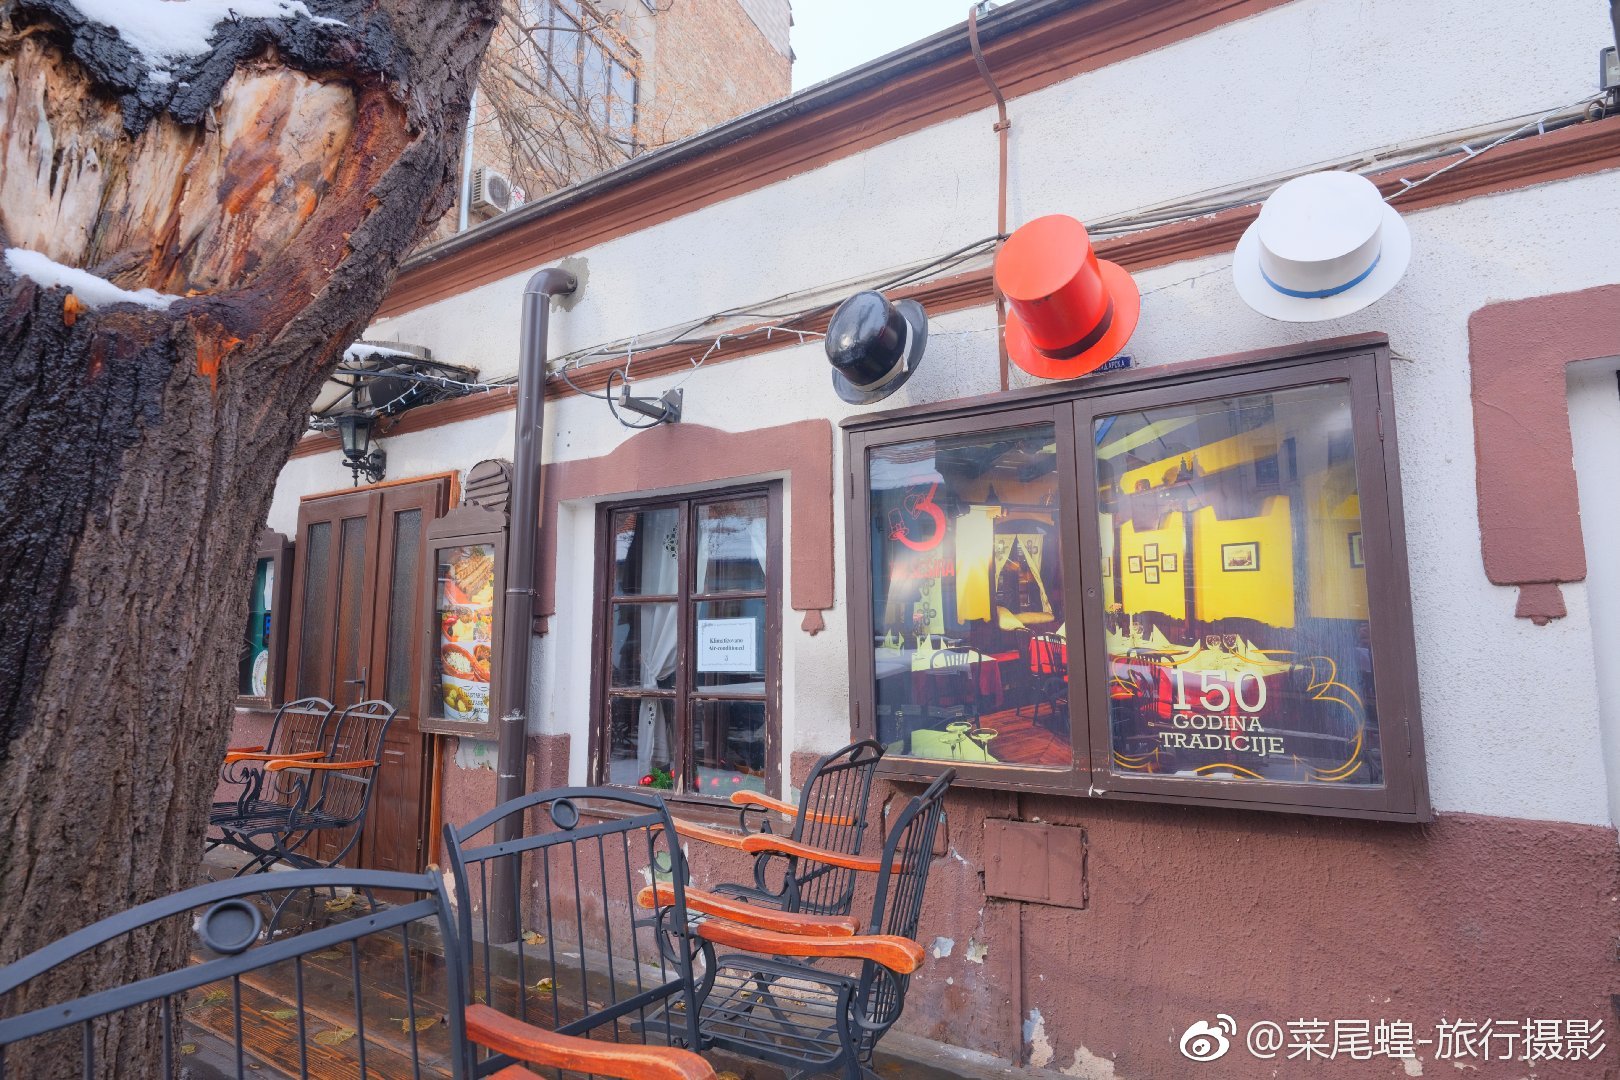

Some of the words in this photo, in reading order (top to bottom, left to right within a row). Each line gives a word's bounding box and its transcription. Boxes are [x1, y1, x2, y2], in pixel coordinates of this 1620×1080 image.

[1170, 668, 1267, 713] 150
[1172, 713, 1265, 733] GODINA
[1159, 732, 1285, 757] TRADICIJE
